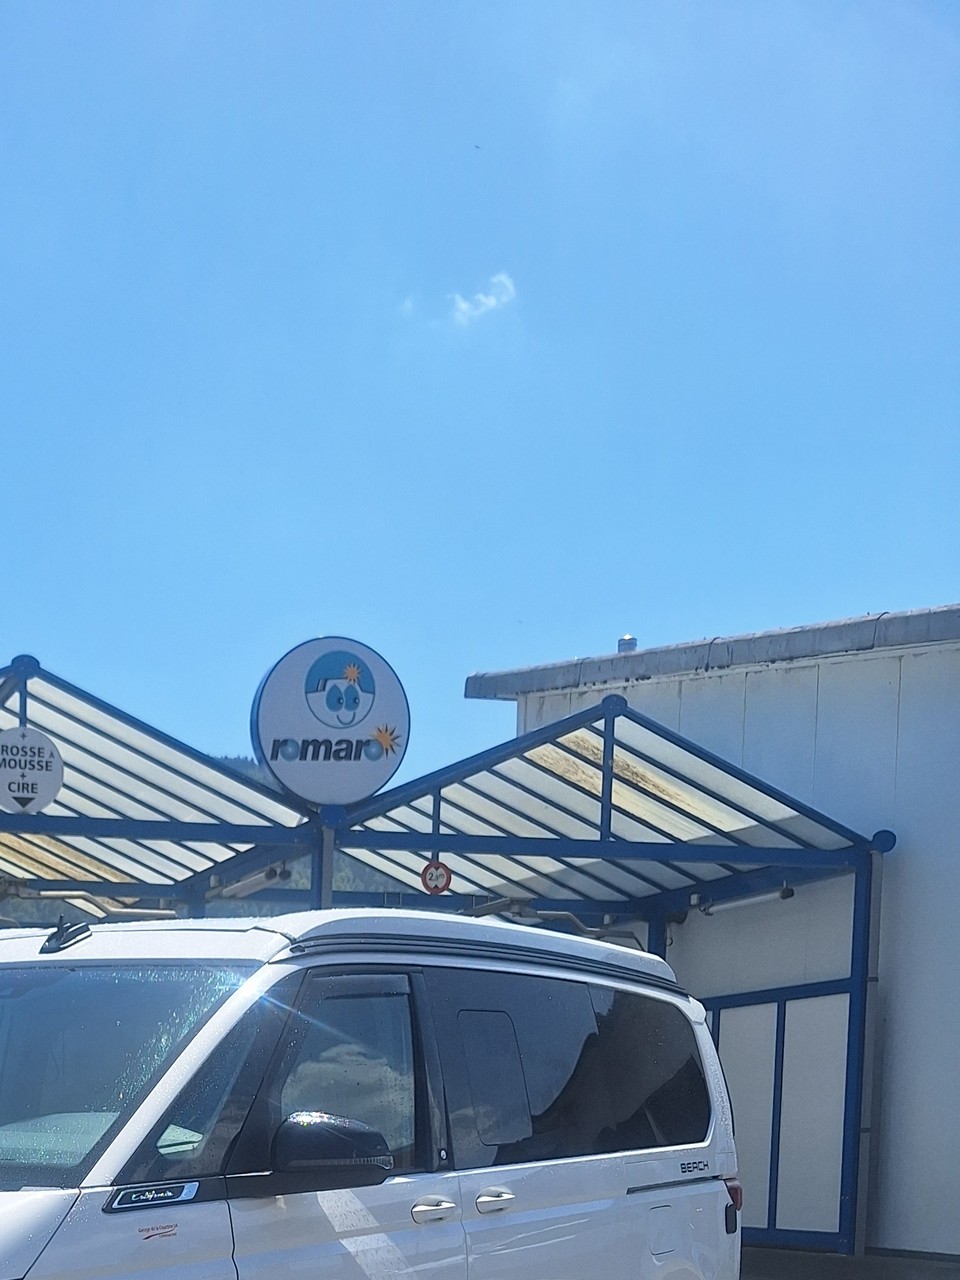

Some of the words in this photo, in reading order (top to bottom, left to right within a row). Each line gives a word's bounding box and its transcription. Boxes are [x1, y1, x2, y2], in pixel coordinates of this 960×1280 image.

[270, 738, 385, 762] romaro
[7, 781, 38, 794] CIRE
[680, 1160, 709, 1174] BEACH
